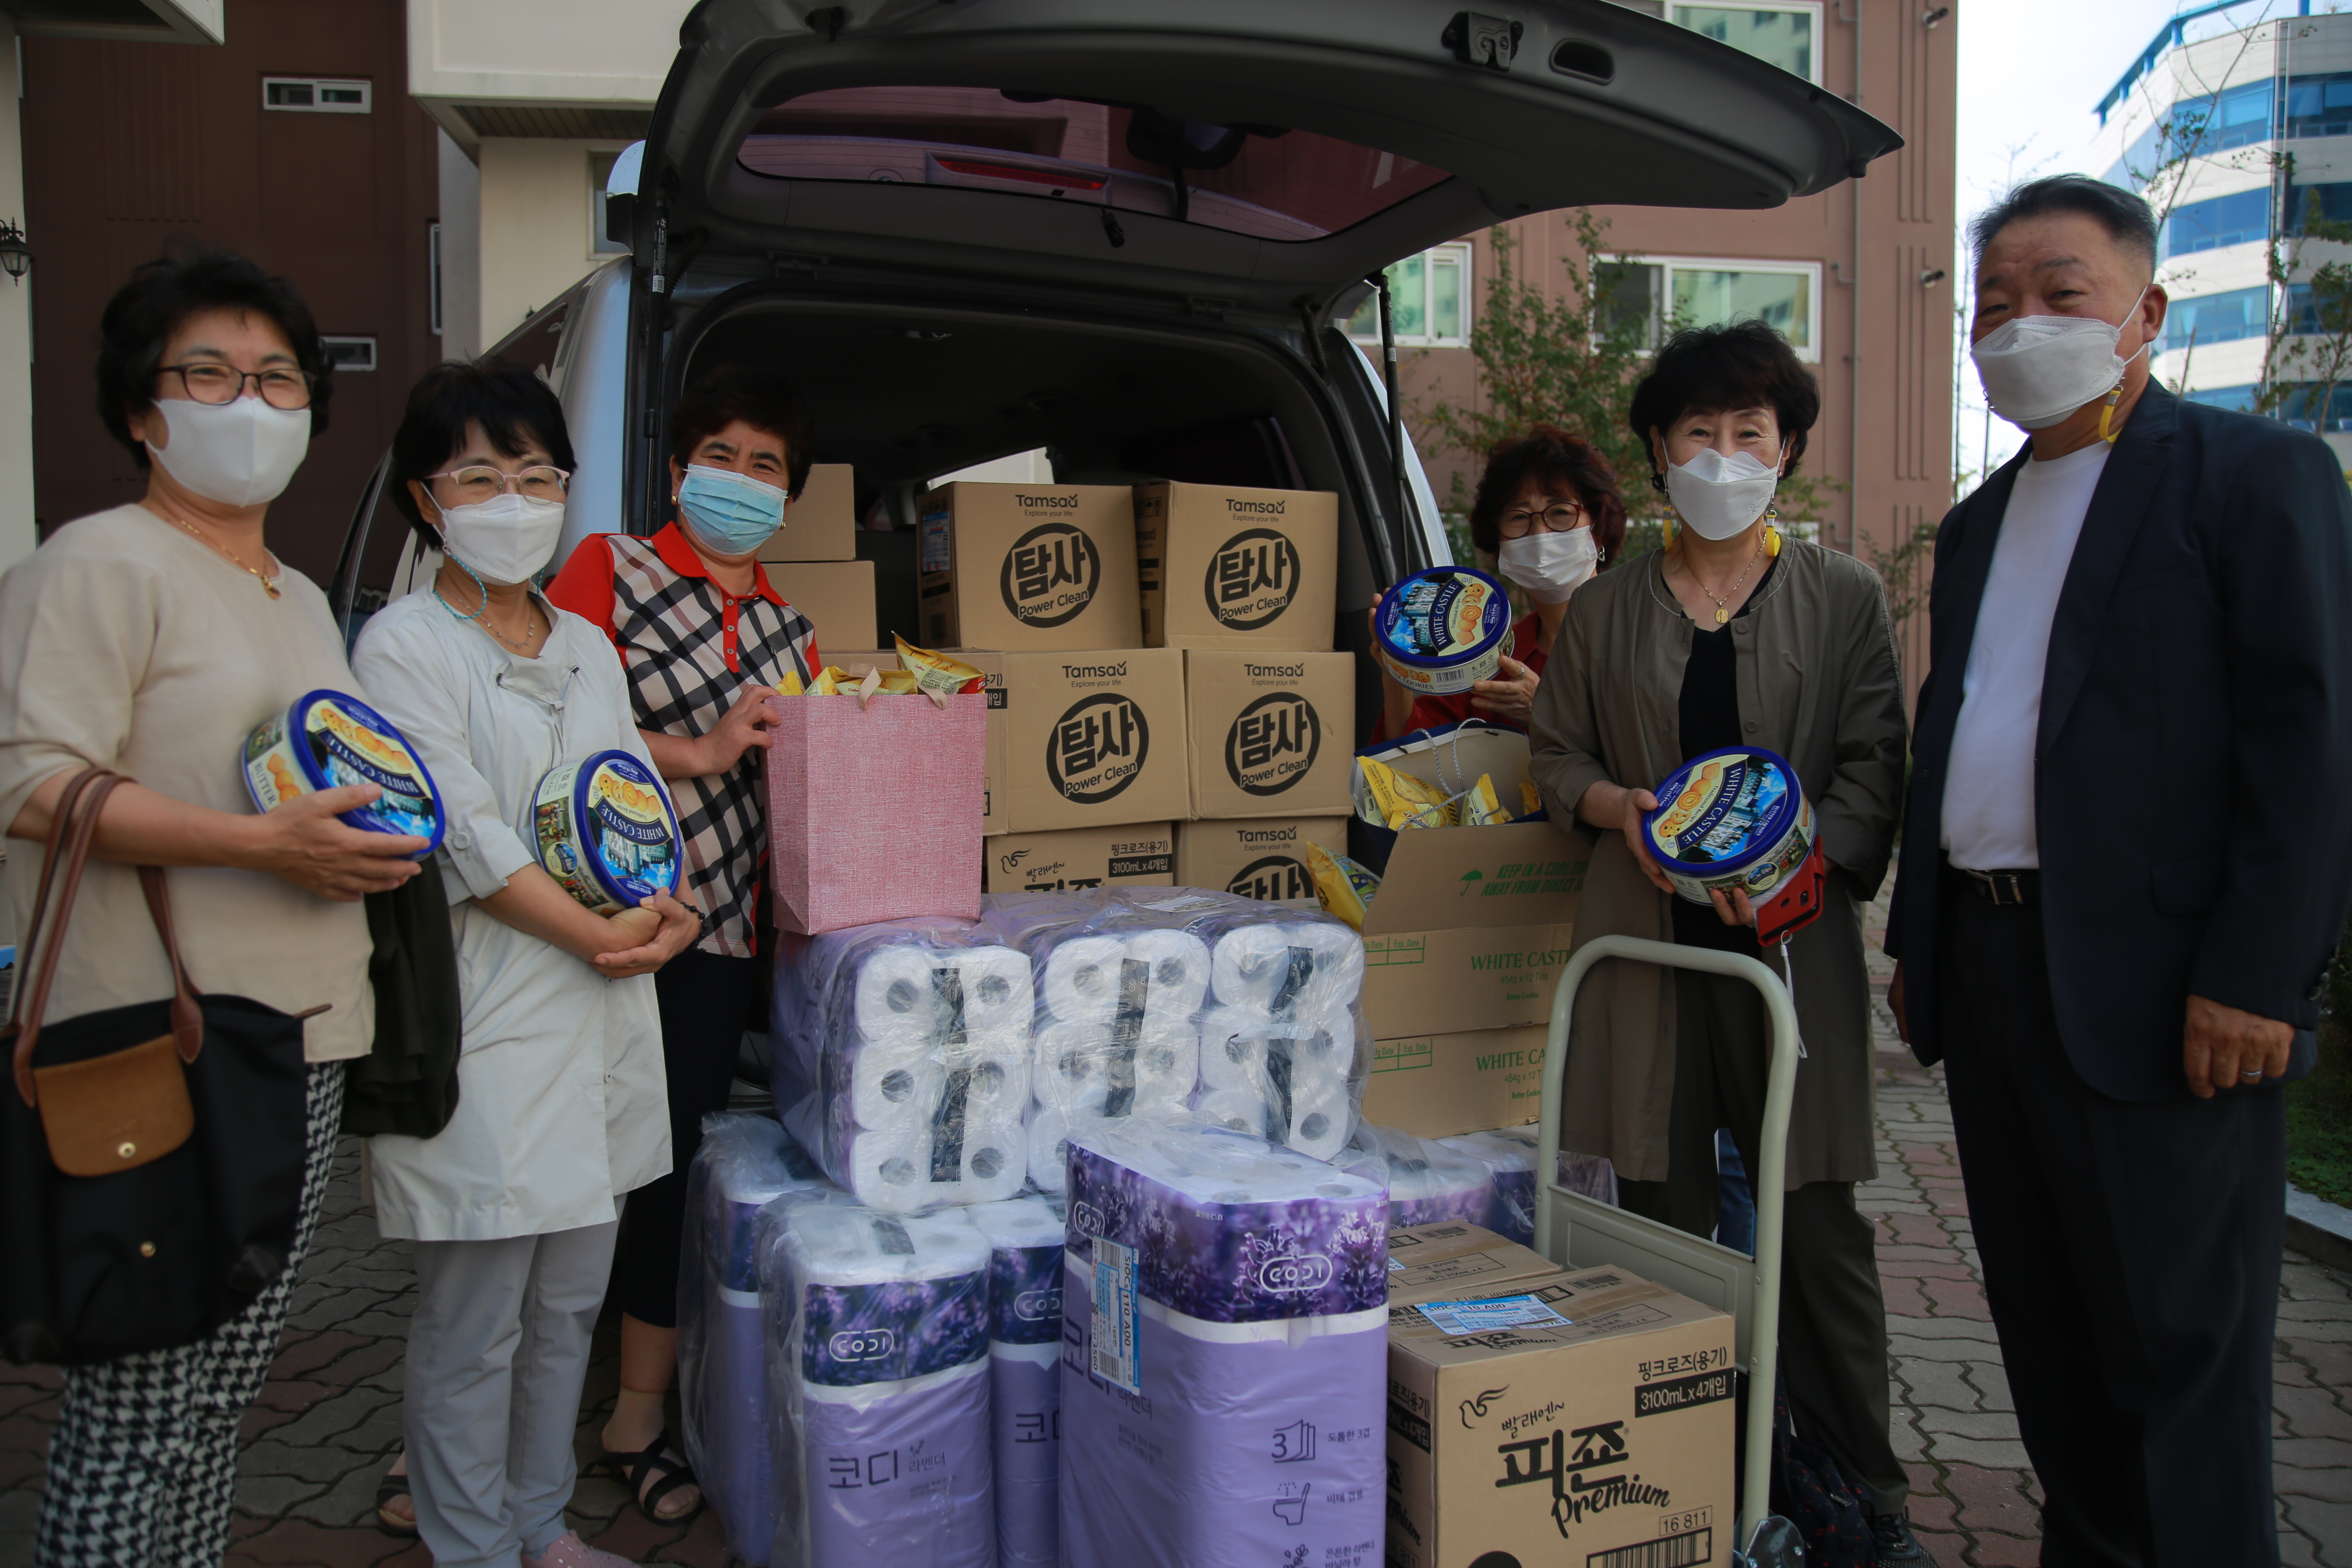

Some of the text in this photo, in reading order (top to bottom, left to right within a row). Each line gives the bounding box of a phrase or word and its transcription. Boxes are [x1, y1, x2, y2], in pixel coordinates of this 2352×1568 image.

[1014, 535, 1086, 601] 탐사
[1220, 540, 1287, 603] 탐사
[1019, 590, 1088, 618] Power Clean
[1220, 595, 1286, 620] Power Clean
[1434, 583, 1458, 646] WHITE CASTLE
[1451, 609, 1459, 629] Traditional
[1403, 678, 1434, 689] COOKIES
[1061, 704, 1133, 777] 탐사
[1240, 704, 1308, 769] 탐사
[326, 736, 376, 777] CASTLE
[1065, 762, 1137, 796] Power Clean
[1241, 759, 1308, 787] Power Clean
[255, 763, 277, 805] BUTTER
[380, 775, 420, 793] WHITE
[1682, 768, 1741, 844] WHITE CASTLE
[1689, 785, 1718, 823] Traditional Recipe
[602, 805, 665, 839] WHITE CASTLE
[1756, 805, 1780, 836] BUTTER COOKIES
[1112, 841, 1168, 856] 핑크로즈(용기)
[1496, 862, 1569, 879] KEEP IN A COOL
[627, 883, 652, 895] BUTTER COOKIES
[1480, 881, 1509, 897] AWAY
[1510, 879, 1542, 895] FROM
[1540, 878, 1575, 894] DIRECT
[1371, 940, 1383, 949] Date
[1394, 940, 1405, 949] Exp.
[1471, 953, 1522, 970] WHITE
[1500, 975, 1517, 984] 454g
[1526, 973, 1533, 982] 12
[1535, 972, 1549, 981] Tins
[1523, 992, 1539, 1000] Cookies
[1382, 1043, 1427, 1056] Date Exp. Date
[1476, 1051, 1524, 1071] WHITE
[1505, 1073, 1521, 1083] 454g
[1528, 1072, 1536, 1080] 12
[1526, 1089, 1540, 1097] Cookie
[1270, 1263, 1322, 1282] CODI
[838, 1338, 886, 1352] CODI
[1638, 1346, 1727, 1381] 핑크로즈(용기)
[829, 1450, 898, 1488] 코디
[909, 1452, 945, 1473] 라벤더
[1495, 1420, 1629, 1500] 피죤
[1327, 1492, 1344, 1504] 비데
[1551, 1473, 1670, 1538] Premium
[1326, 1547, 1351, 1559] 은은한
